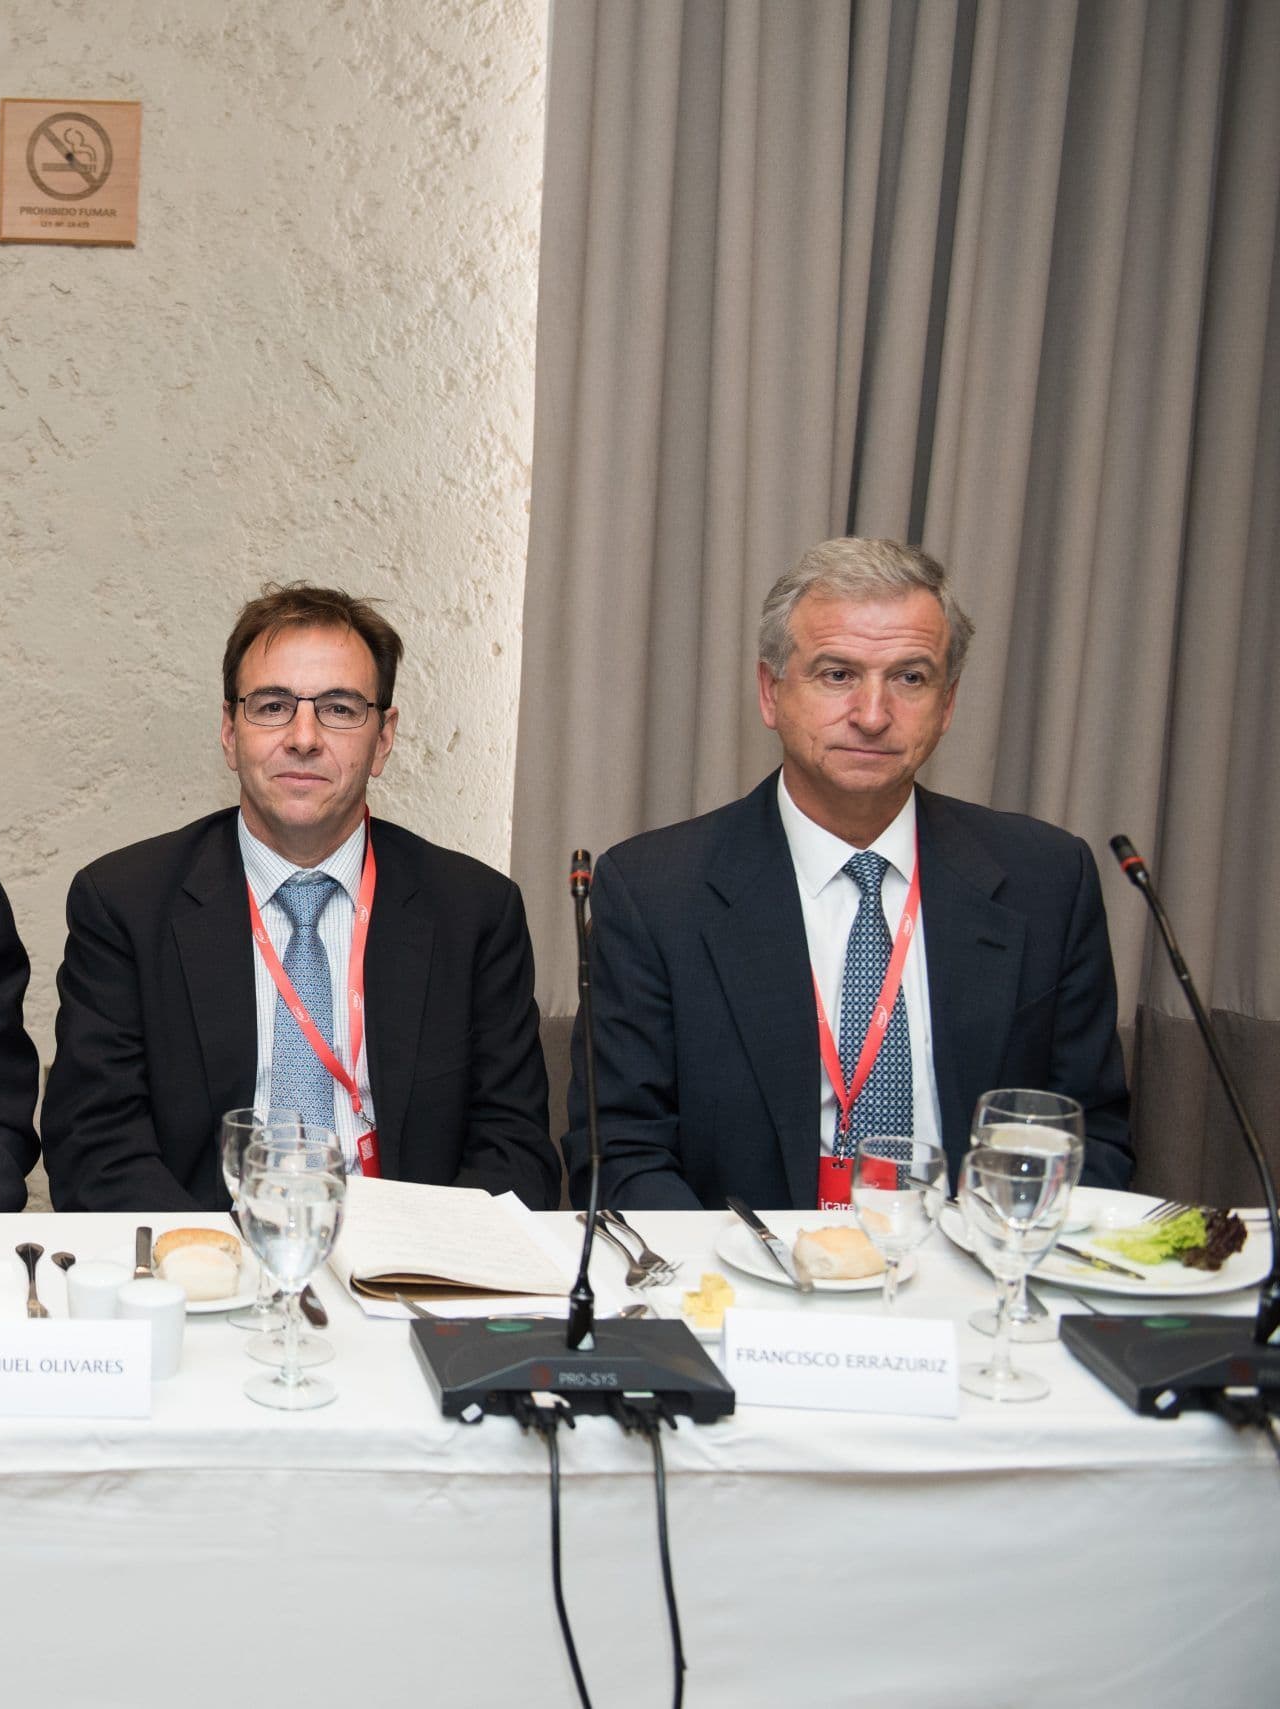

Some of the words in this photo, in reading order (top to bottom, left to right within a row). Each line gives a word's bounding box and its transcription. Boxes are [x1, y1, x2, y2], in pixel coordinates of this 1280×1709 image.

[19, 205, 77, 217] PROHIBIDO
[79, 207, 117, 218] FUMAR
[39, 1358, 124, 1374] OLIVARES
[735, 1347, 841, 1369] FRANCISCO
[557, 1371, 618, 1387] PRO-SYS
